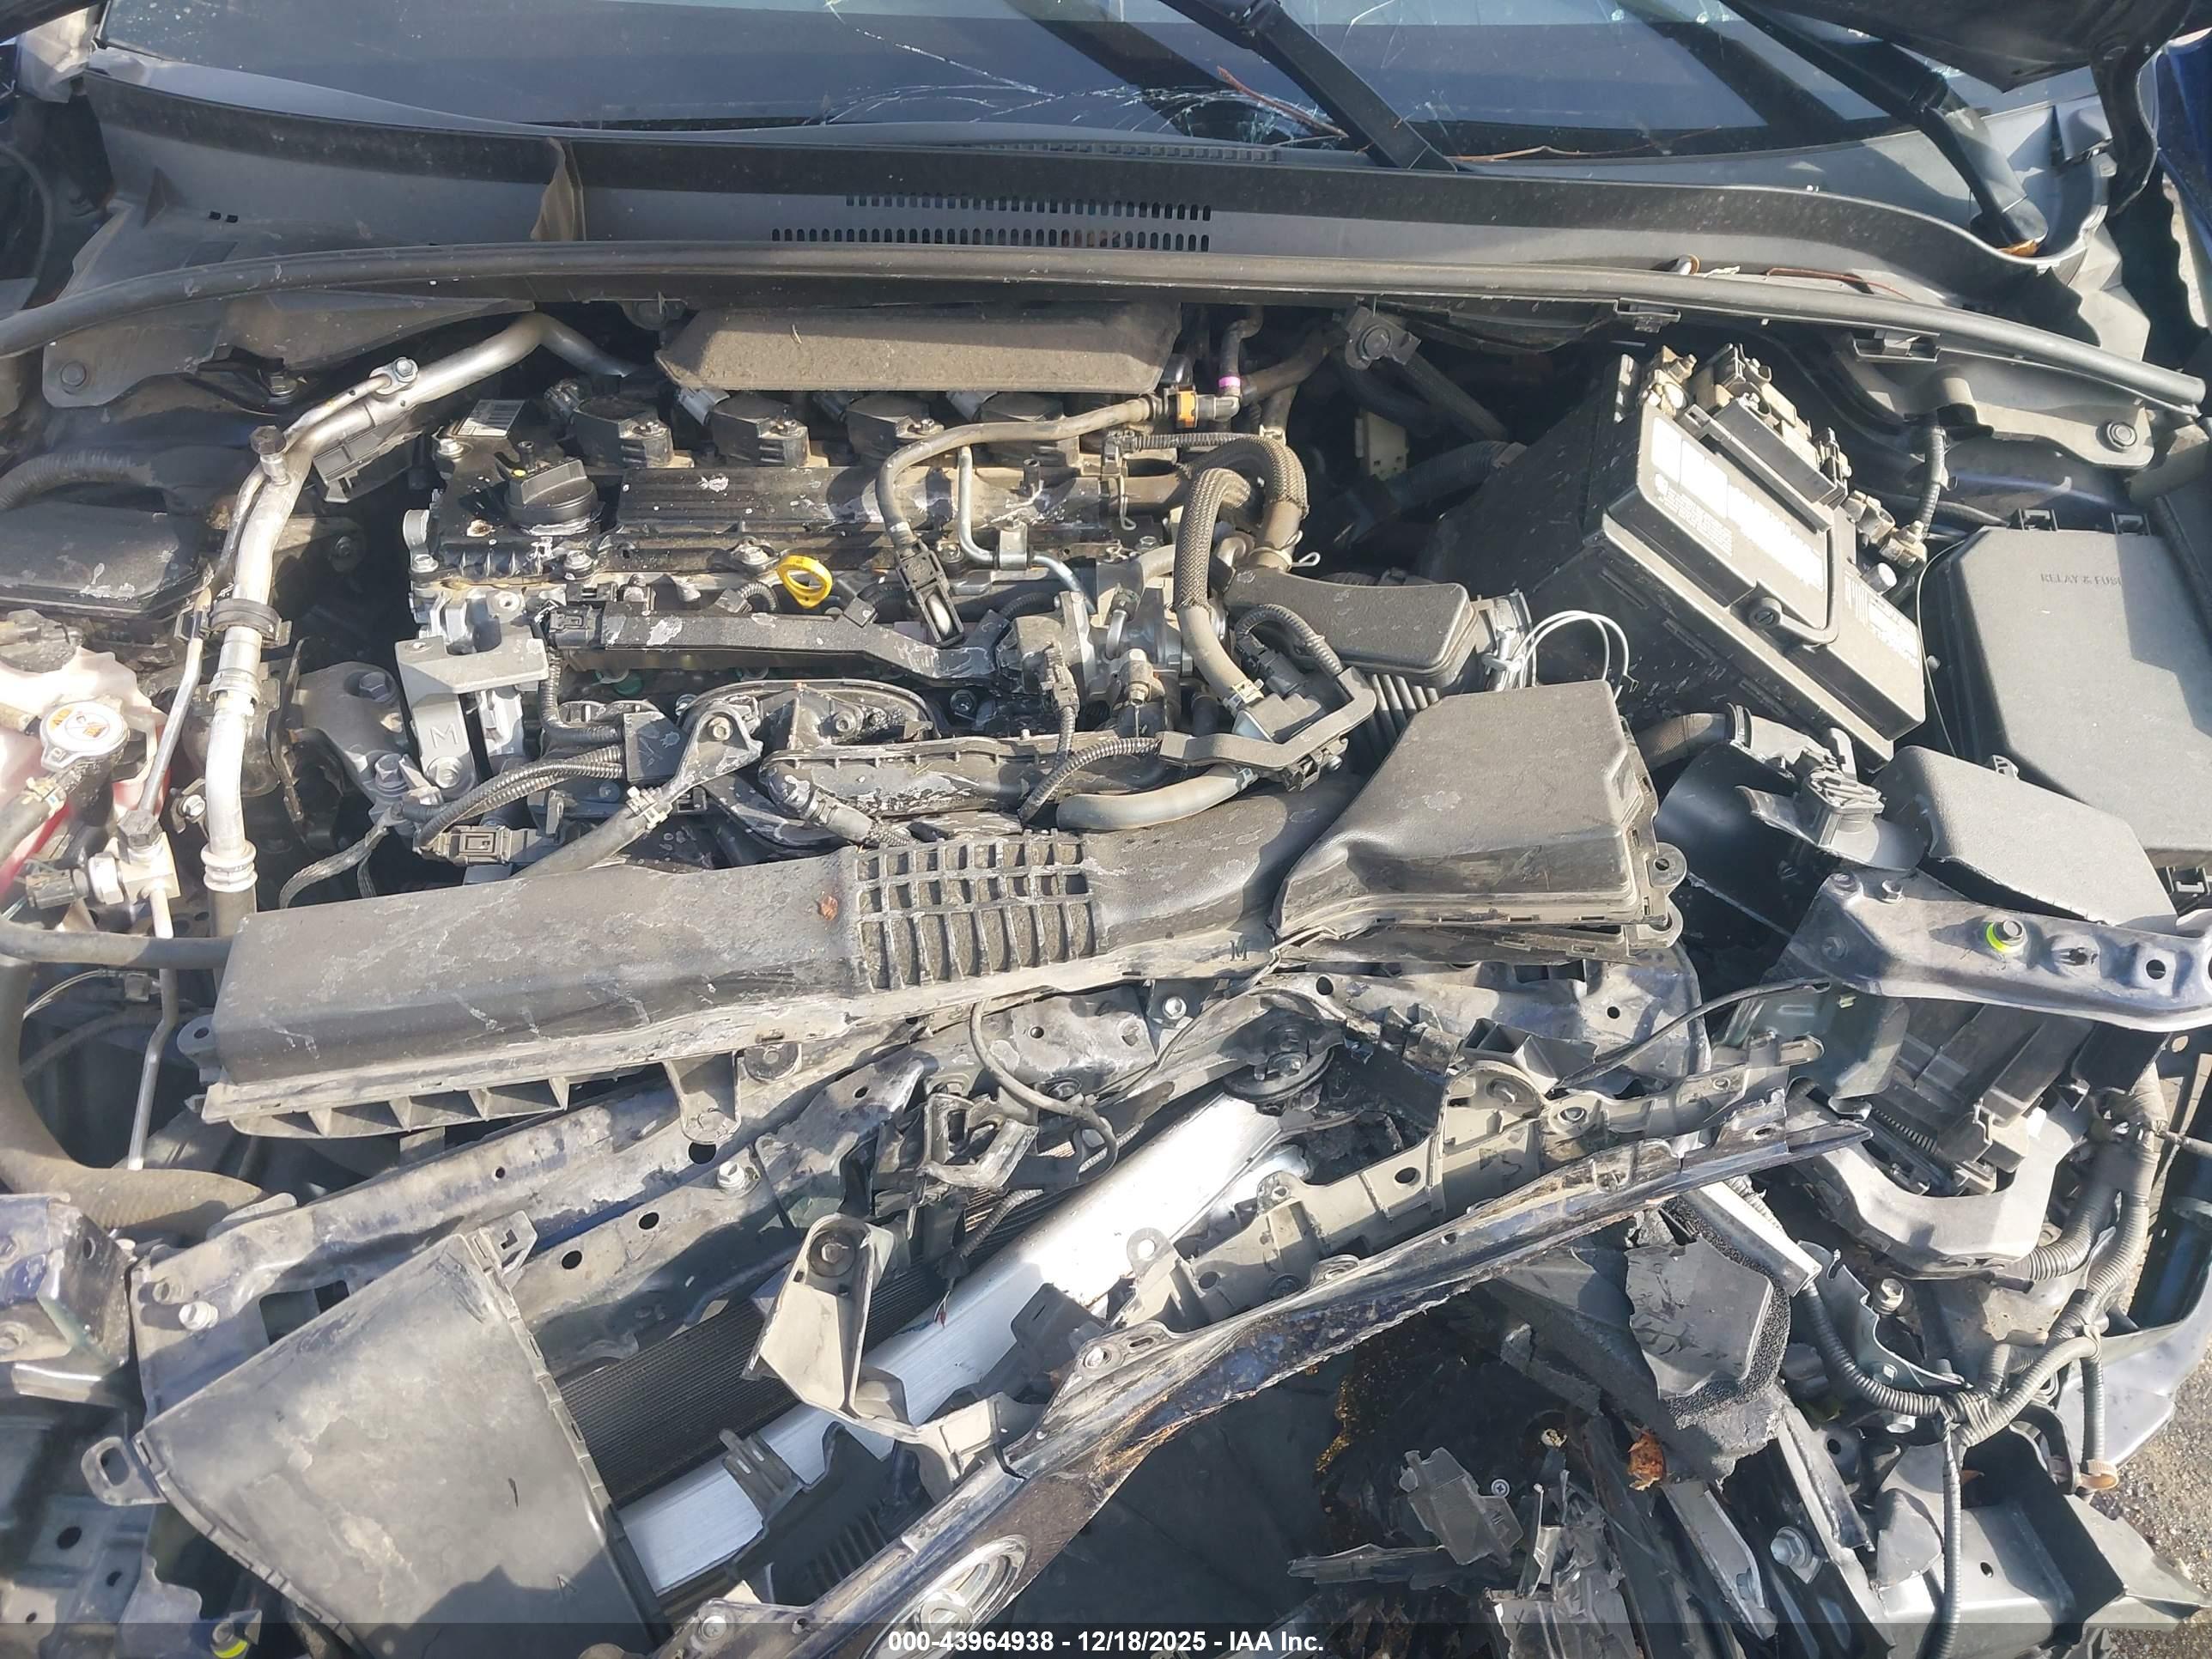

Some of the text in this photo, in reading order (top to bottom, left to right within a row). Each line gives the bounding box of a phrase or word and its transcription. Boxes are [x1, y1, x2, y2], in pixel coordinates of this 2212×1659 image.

[2040, 573, 2080, 584] RELAY
[2081, 574, 2093, 585] &
[429, 723, 459, 749] M
[1230, 939, 1250, 962] M
